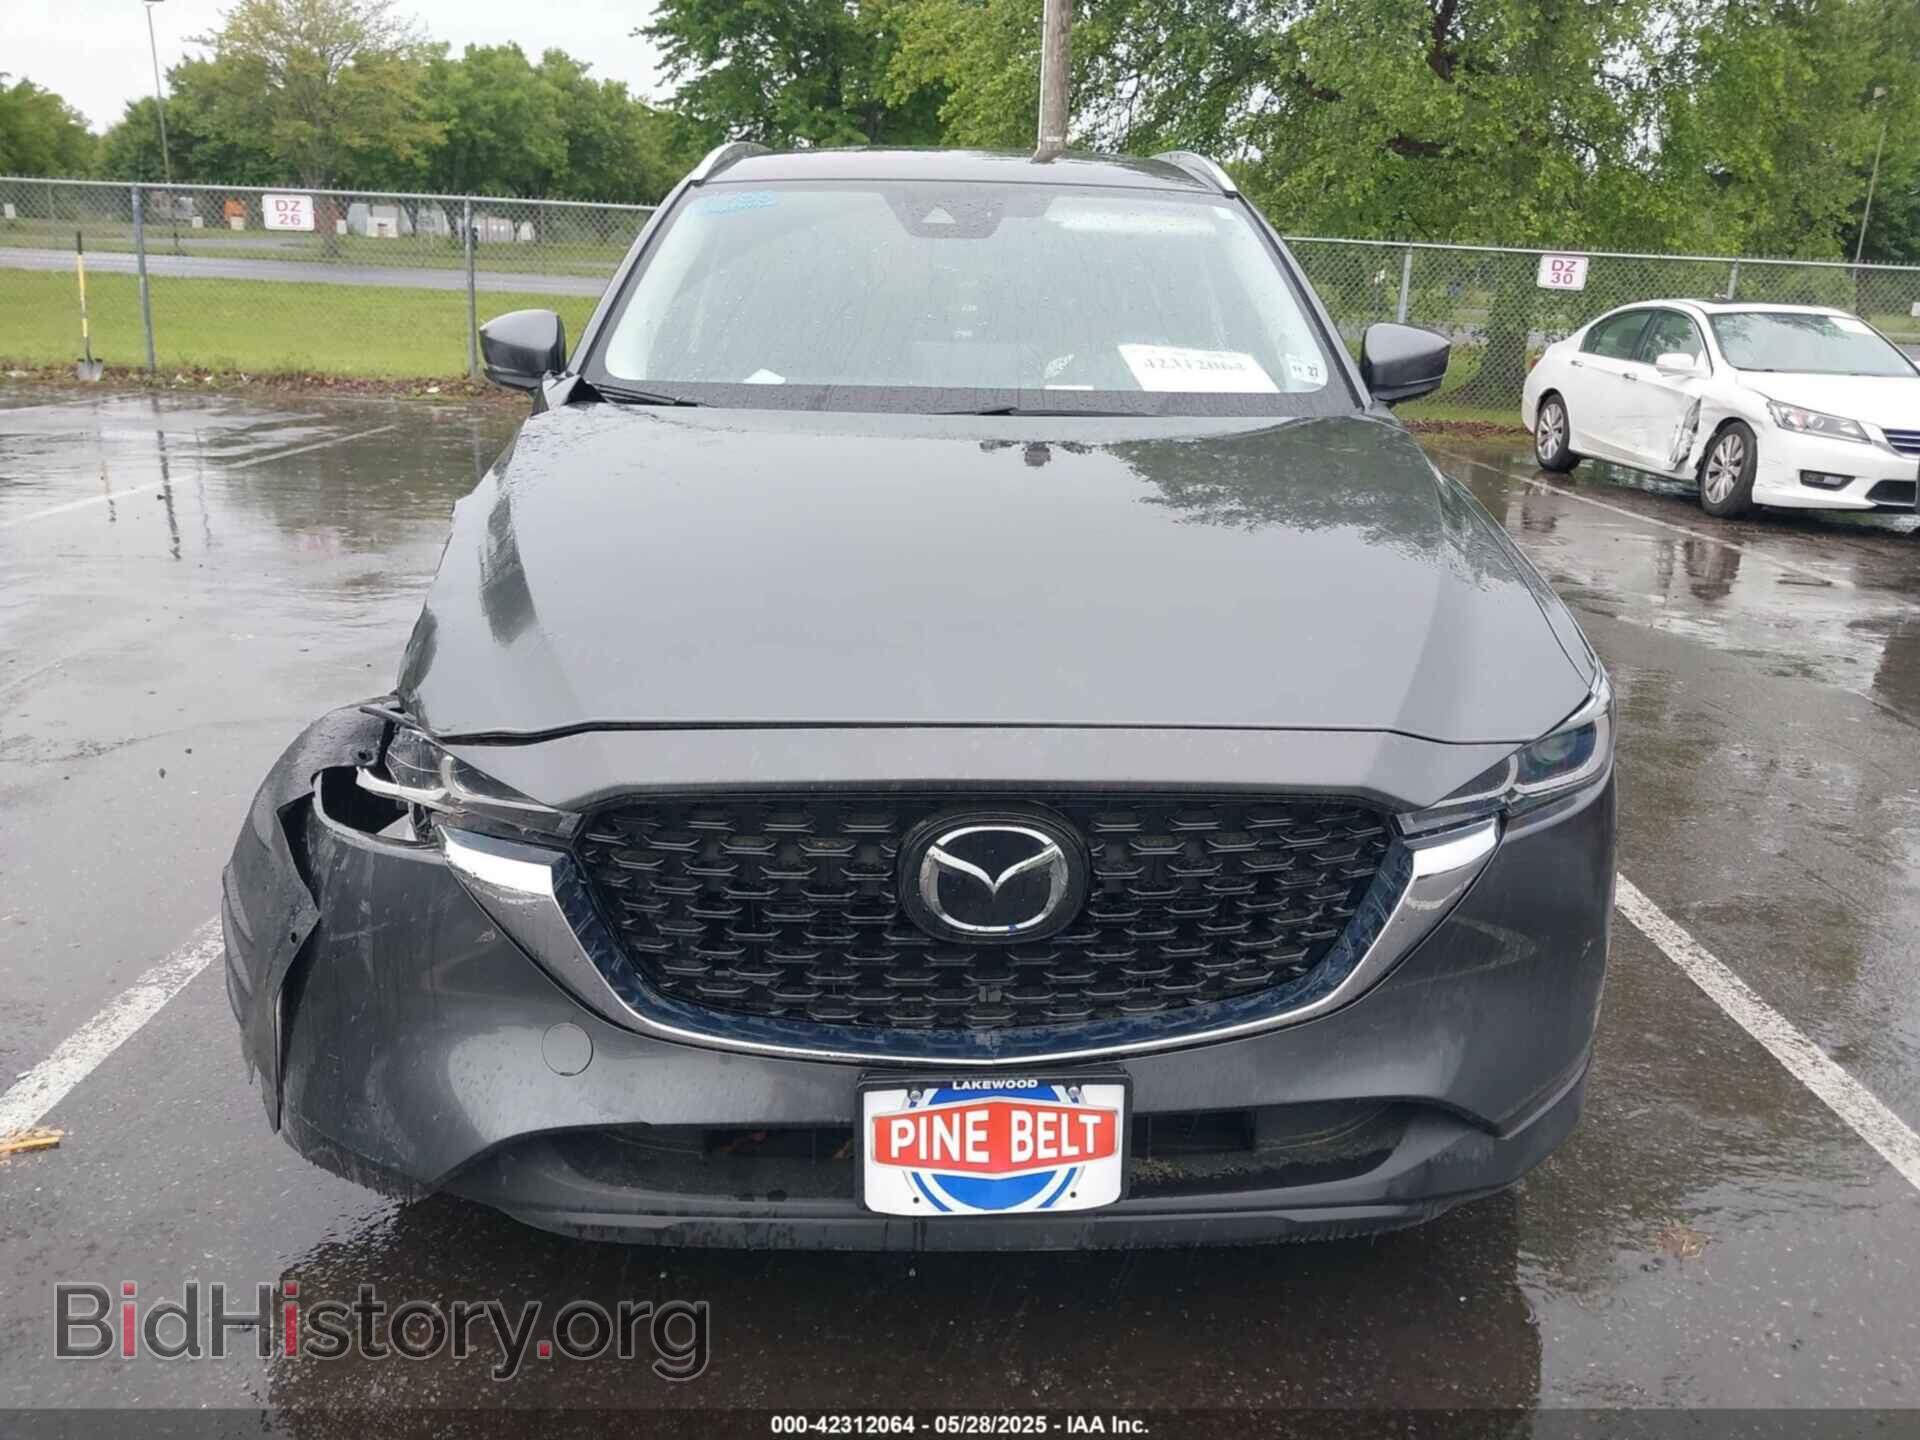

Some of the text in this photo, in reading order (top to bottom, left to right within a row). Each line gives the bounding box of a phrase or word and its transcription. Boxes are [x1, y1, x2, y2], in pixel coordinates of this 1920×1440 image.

[275, 200, 302, 212] DZ
[279, 214, 301, 225] 26
[1552, 260, 1577, 272] DZ
[1551, 272, 1573, 285] 30
[952, 1079, 1039, 1091] LAKEWOOD
[890, 1110, 1102, 1164] PINE BELT
